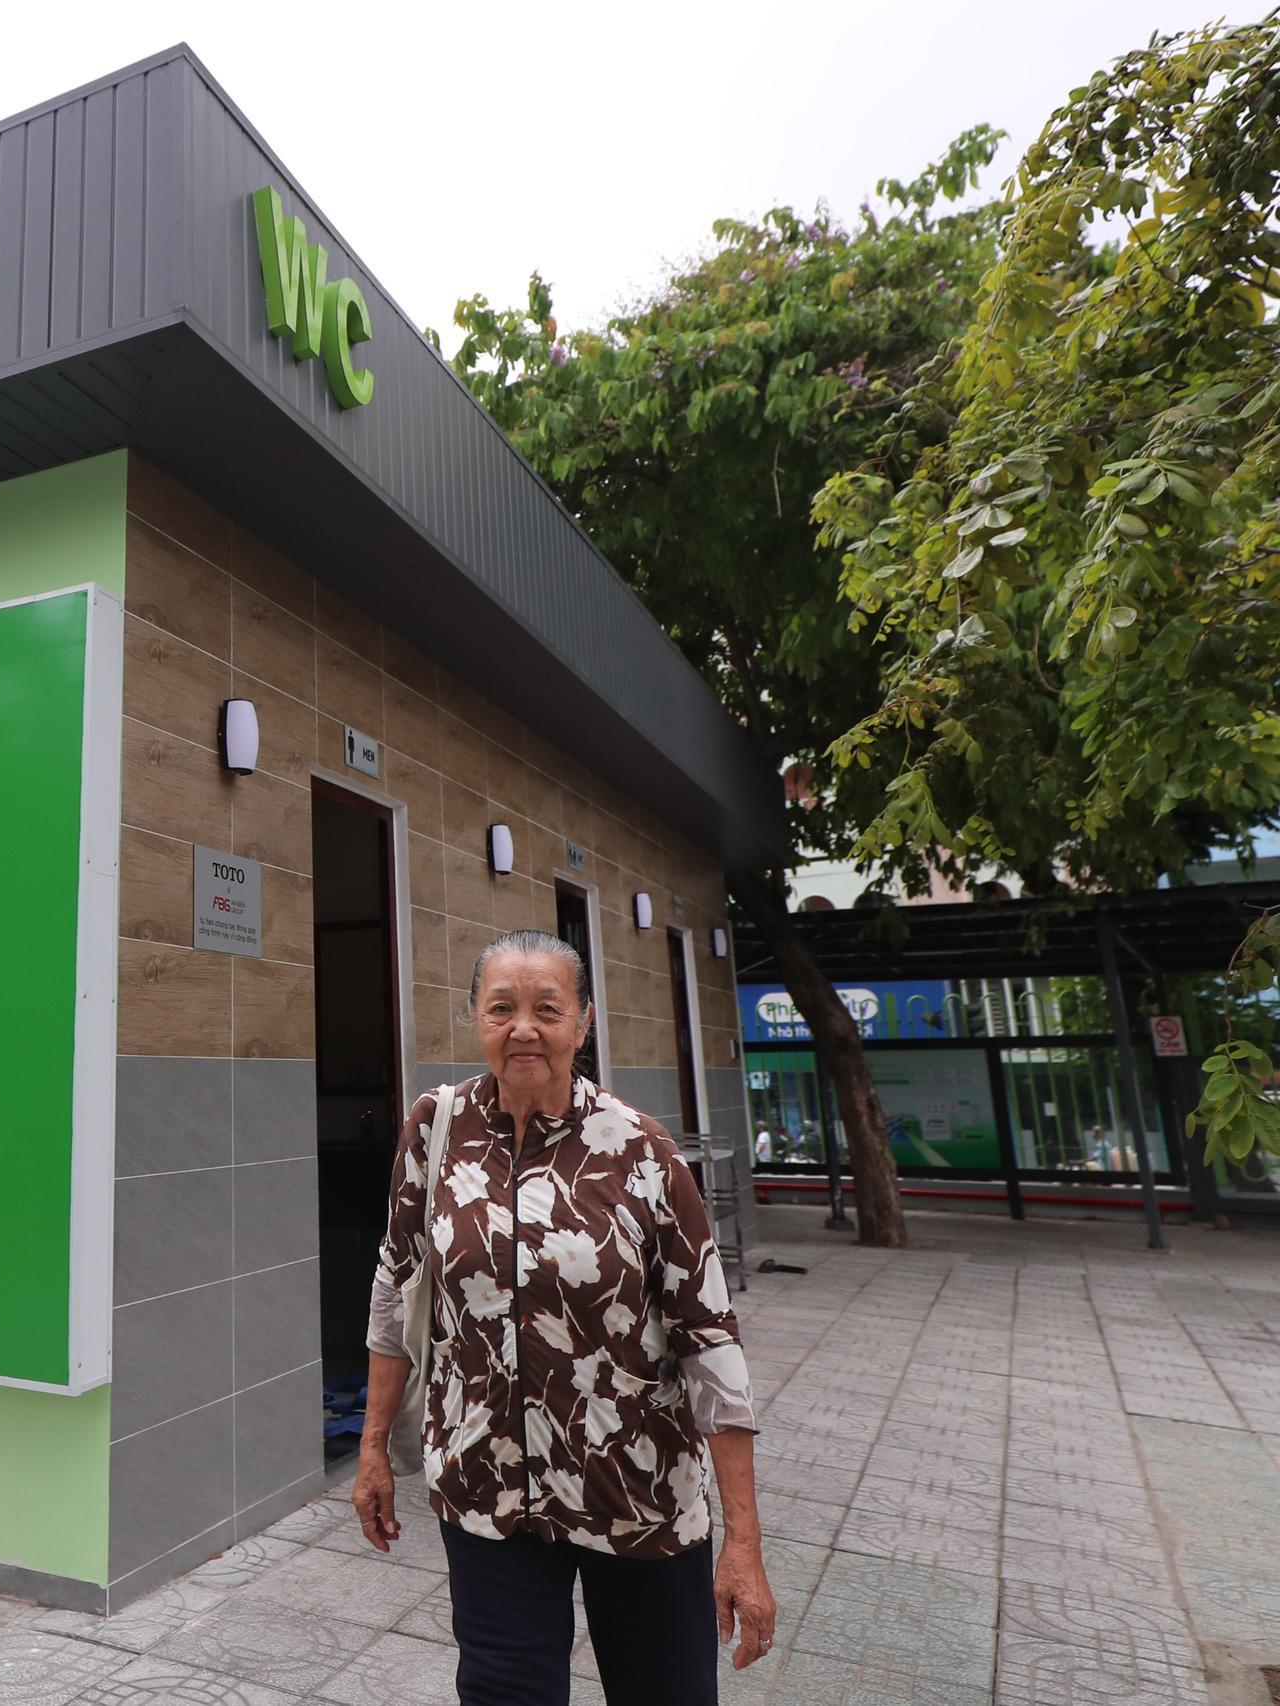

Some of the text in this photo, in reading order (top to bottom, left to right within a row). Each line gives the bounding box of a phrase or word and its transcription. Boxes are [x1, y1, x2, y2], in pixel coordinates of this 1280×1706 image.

[251, 184, 375, 409] WC
[362, 746, 376, 764] MEN
[212, 862, 245, 884] TOTO
